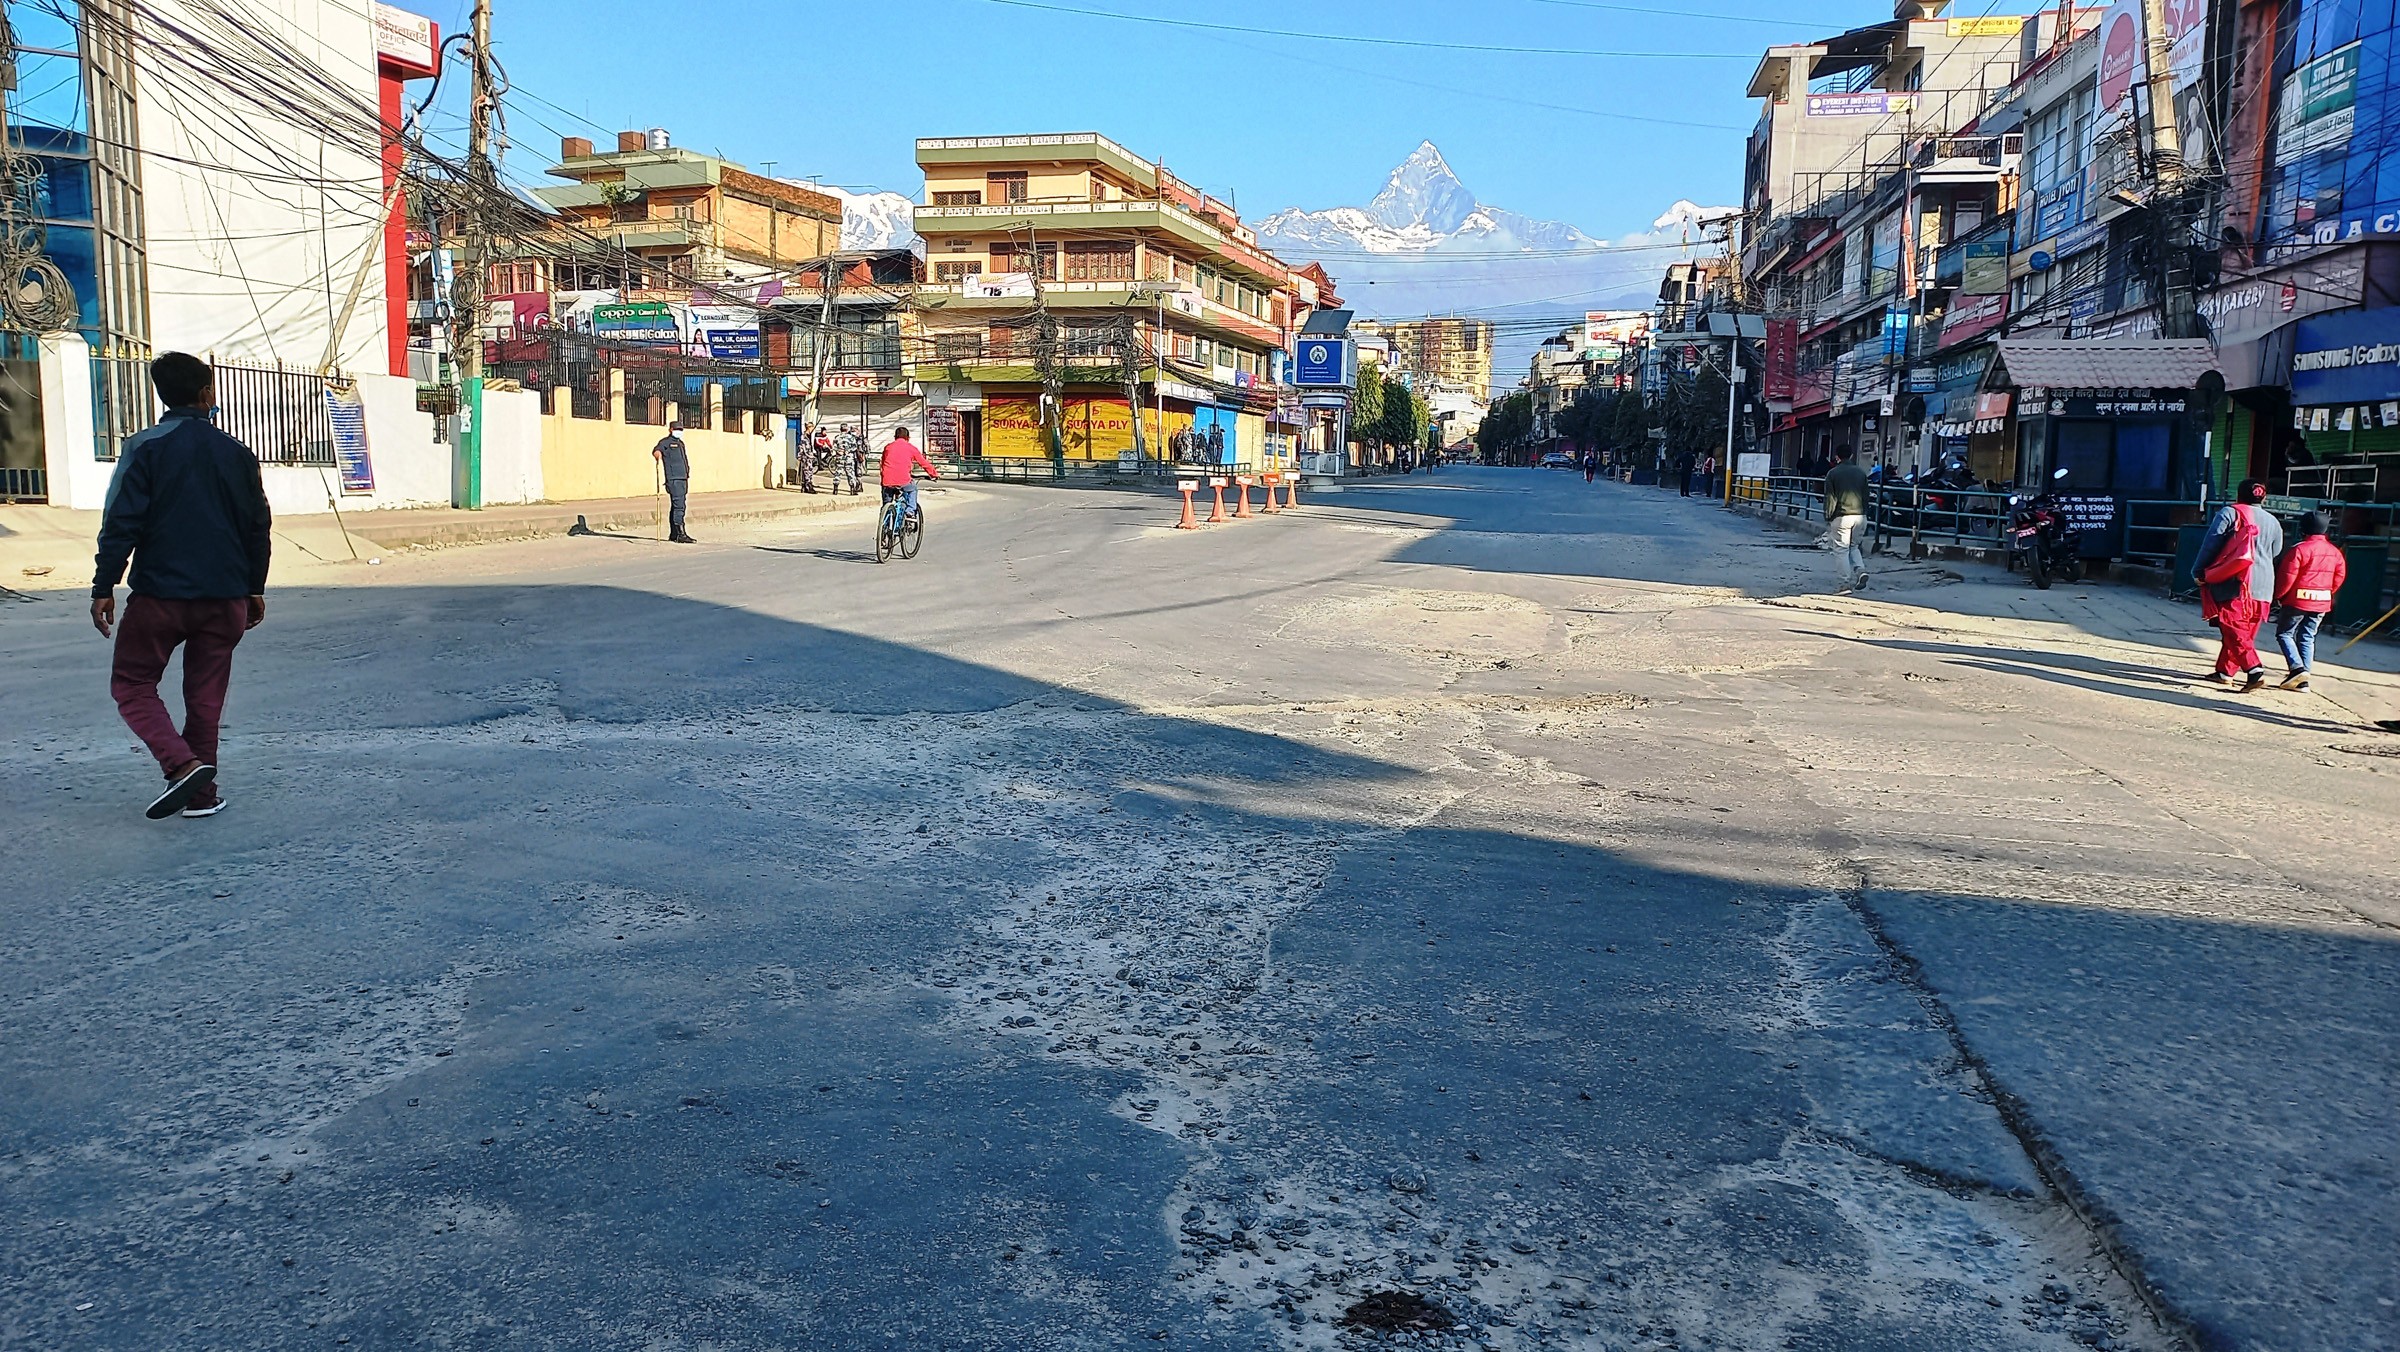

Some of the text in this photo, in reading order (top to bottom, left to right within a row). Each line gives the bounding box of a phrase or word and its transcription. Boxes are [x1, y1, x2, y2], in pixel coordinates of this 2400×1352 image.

[380, 32, 406, 46] OFFICE
[2221, 284, 2267, 316] BAKERY
[599, 329, 645, 341] SAMSUNG
[2293, 348, 2351, 371] SAMSUNG
[2018, 402, 2046, 415] POLICE BEAT
[993, 420, 1030, 429] SURYA
[1067, 420, 1129, 430] SURYA PLY
[2278, 502, 2301, 510] STAND
